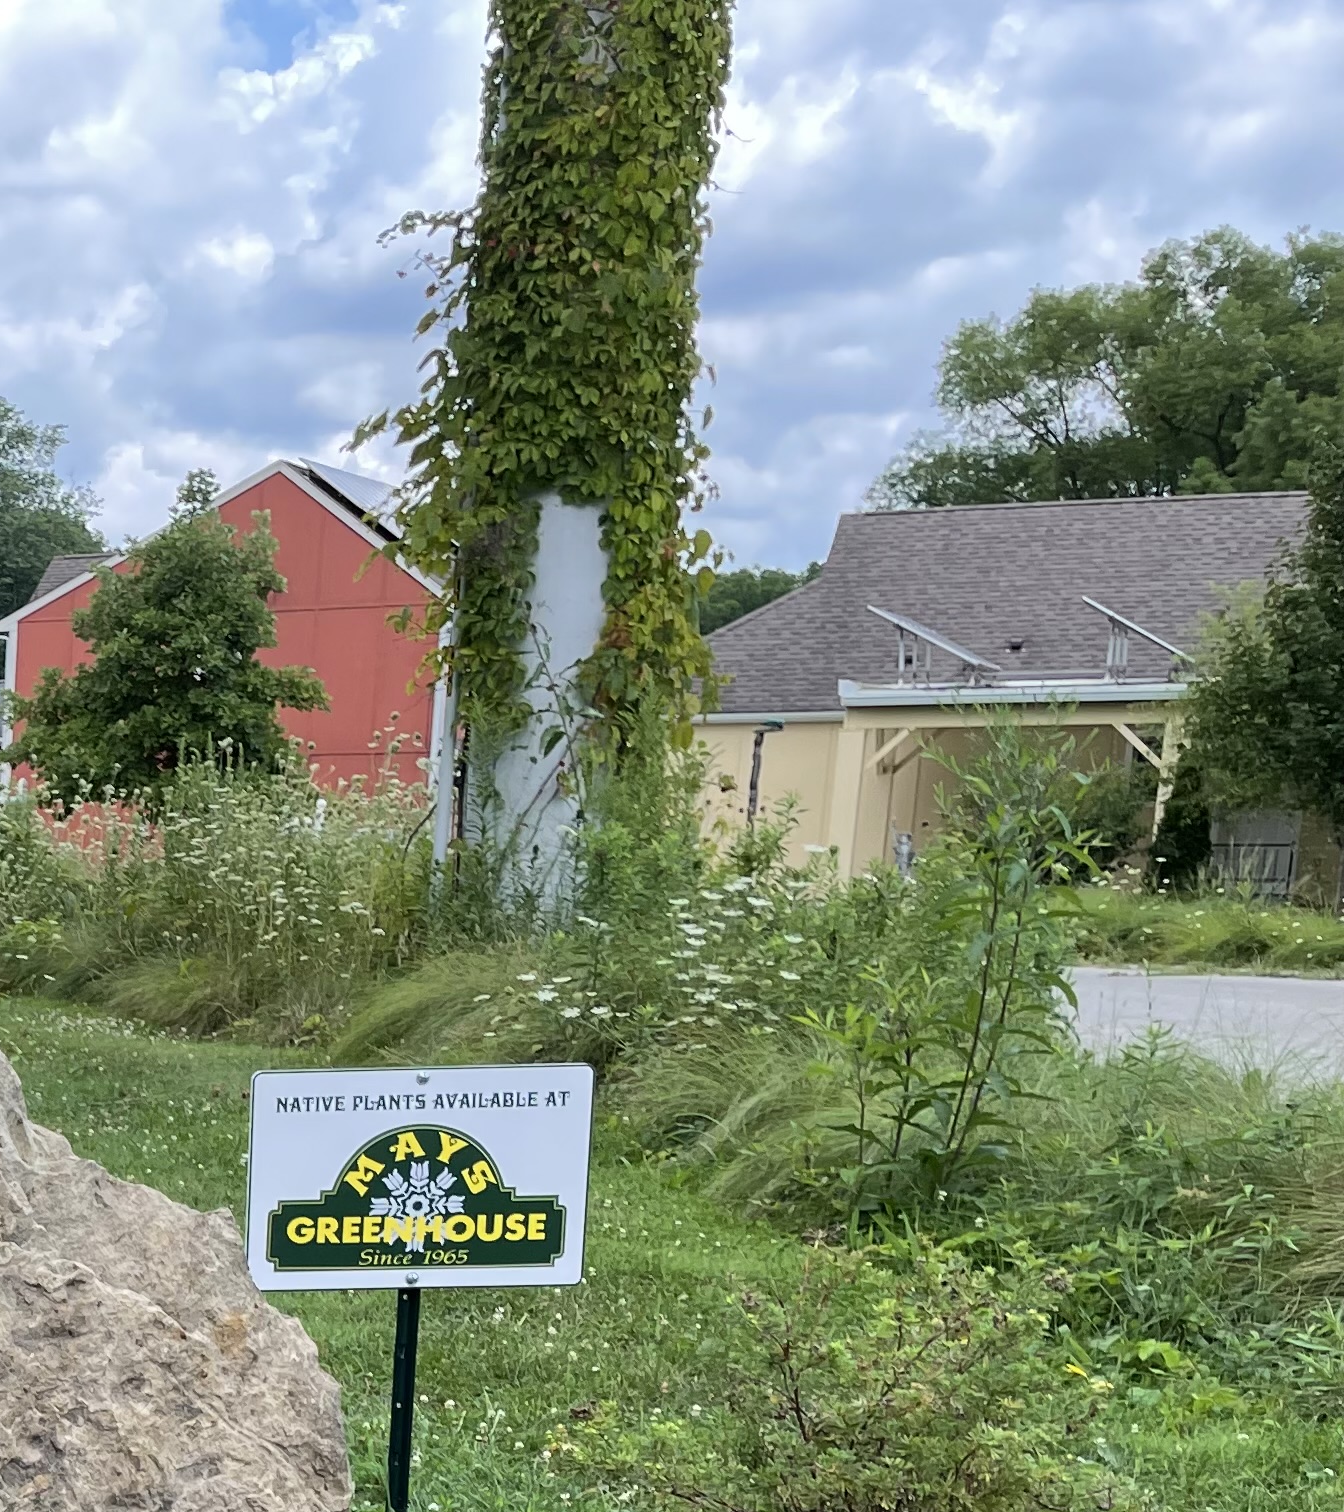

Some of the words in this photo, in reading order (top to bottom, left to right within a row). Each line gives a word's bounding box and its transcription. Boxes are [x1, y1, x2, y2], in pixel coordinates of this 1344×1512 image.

[276, 1096, 345, 1113] NATIVE
[353, 1094, 426, 1111] PLANTS
[434, 1092, 538, 1109] AVAILABLE
[545, 1091, 570, 1107] AT
[344, 1131, 497, 1197] MAYS
[286, 1213, 546, 1244] GREENHOUSE
[358, 1249, 412, 1266] Since
[422, 1249, 468, 1265] 1965
